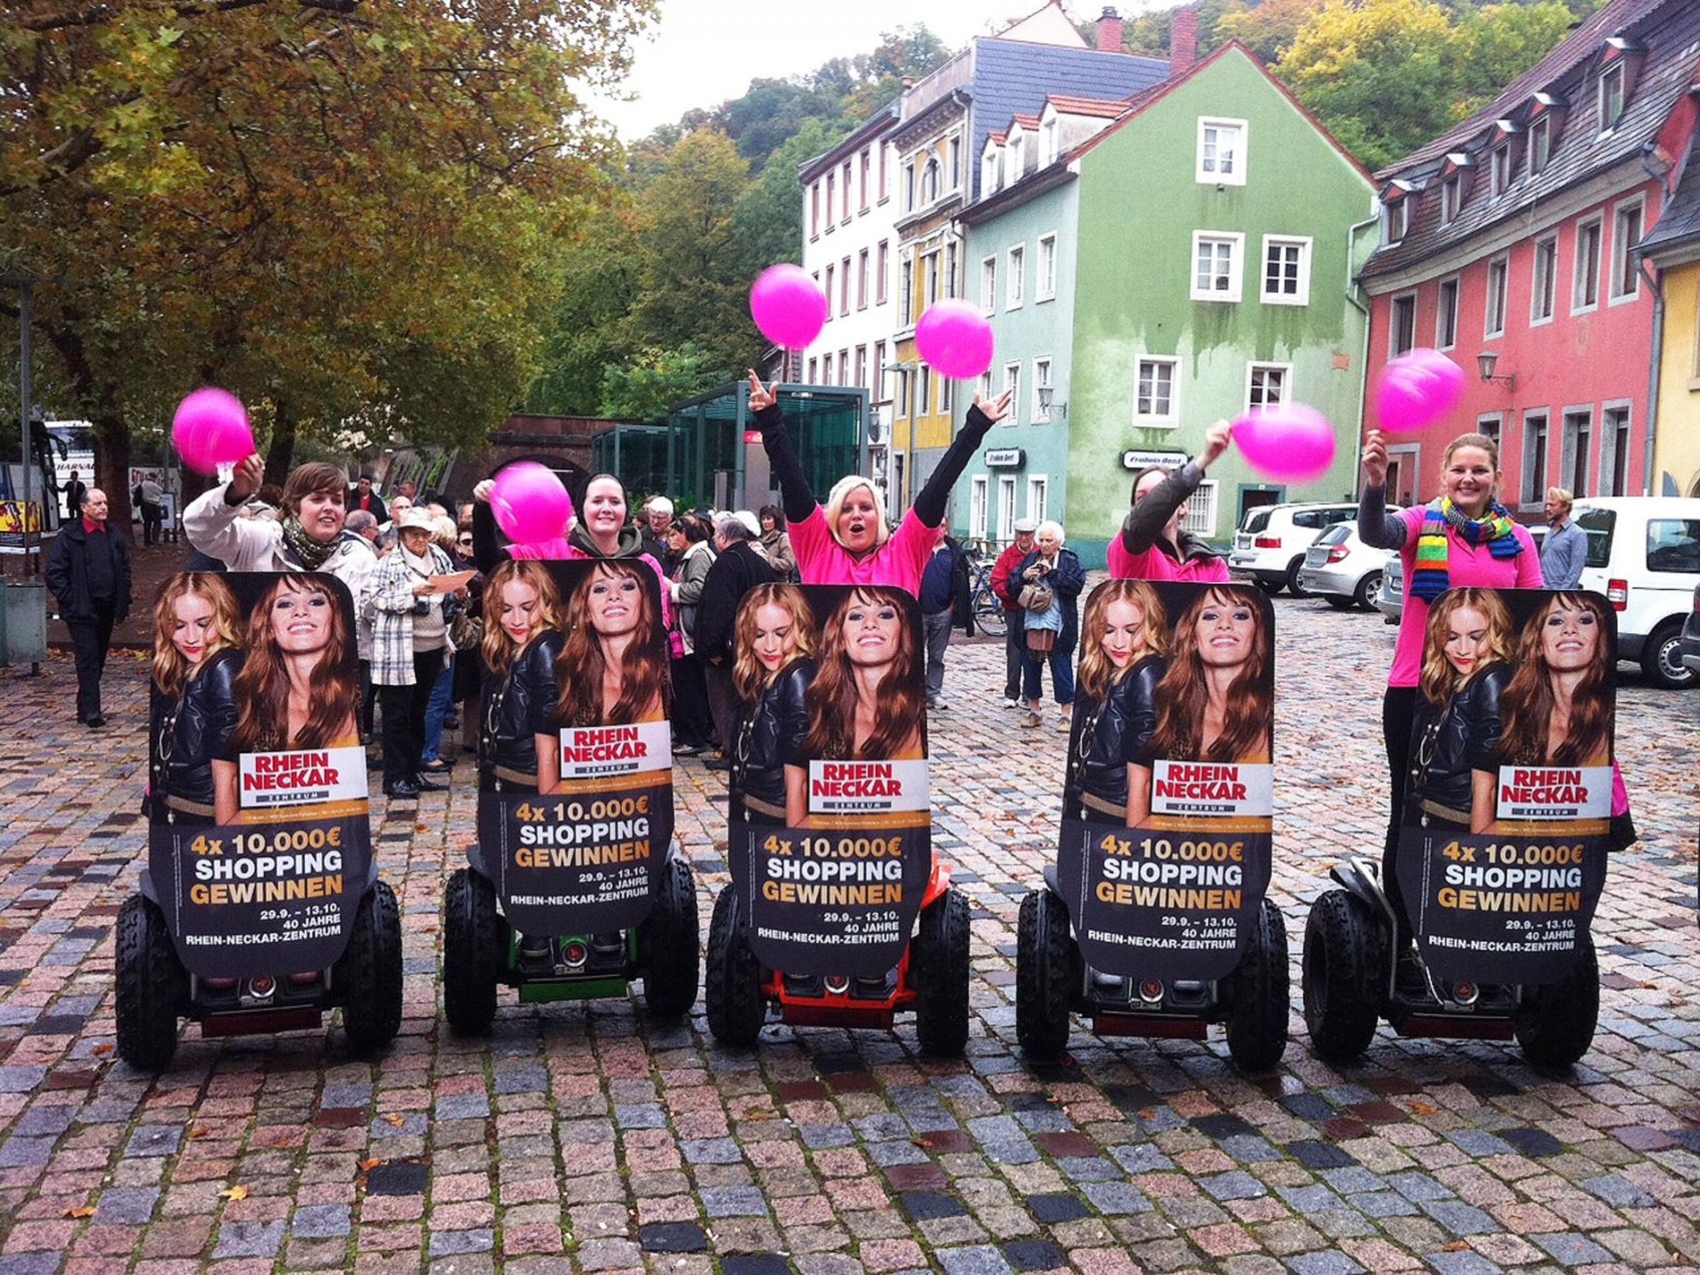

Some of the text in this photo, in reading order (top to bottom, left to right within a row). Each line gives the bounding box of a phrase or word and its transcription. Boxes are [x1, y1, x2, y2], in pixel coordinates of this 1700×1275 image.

[574, 727, 638, 746] RHEIN
[564, 743, 647, 762] NECKAR
[255, 753, 328, 772] RHEIN
[823, 764, 892, 780] RHEIN
[244, 769, 339, 791] NECKAR
[1168, 765, 1238, 782] RHEIN
[1514, 770, 1581, 786] RHEIN
[269, 792, 319, 801] ZENTRUM
[812, 780, 901, 797] NECKAR
[1156, 781, 1246, 800] NECKAR
[1502, 786, 1588, 804] NECKAR
[516, 796, 648, 821] 4x 10.000€
[1178, 804, 1225, 812] ZENTRUM
[520, 818, 648, 844] SHOPPING
[191, 827, 341, 855] 4x 10.000€
[764, 835, 902, 857] 4x 10.000€
[1101, 835, 1244, 861] 4x 10.000€
[515, 840, 649, 867] GEWINNEN
[1443, 842, 1584, 865] 4x 10.000€
[195, 851, 342, 880] SHOPPING
[579, 873, 606, 883] 29.9.
[619, 867, 648, 878] 13.10.
[768, 859, 902, 881] SHOPPING
[1103, 859, 1242, 886] SHOPPING
[599, 877, 648, 891] 40 JAHRE
[1446, 865, 1581, 888] SHOPPING
[190, 875, 343, 905] GEWINNEN
[511, 887, 648, 905] RHEIN-NECKAR-ZENTRUM
[763, 882, 902, 904] GEWINNEN
[1096, 882, 1242, 909] GEWINNEN
[1438, 888, 1581, 912] GEWINNEN
[260, 909, 291, 920] 29.9.
[306, 903, 340, 915] 13.10.
[824, 913, 853, 922] 29.9.
[866, 911, 899, 921] 13.10.
[283, 914, 340, 929] 40 JAHRE
[845, 923, 899, 932] 40 JAHRE
[1162, 917, 1191, 926] 29.9.
[1204, 917, 1237, 926] 13.10.
[1506, 921, 1534, 930] 29.9.
[1547, 919, 1575, 928] 13.10.
[186, 925, 341, 945] RHEIN-NECKAR-ZENTRUM
[758, 928, 899, 944] RHEIN-NECKAR-ZENTRUM
[1088, 930, 1236, 949] RHEIN-NECKAR-ZENTRUM
[1182, 928, 1236, 938] 40 JAHRE
[1526, 930, 1575, 940] 40 JAHRE
[1429, 936, 1574, 951] RHEIN-NECKAR-ZENTRUM
